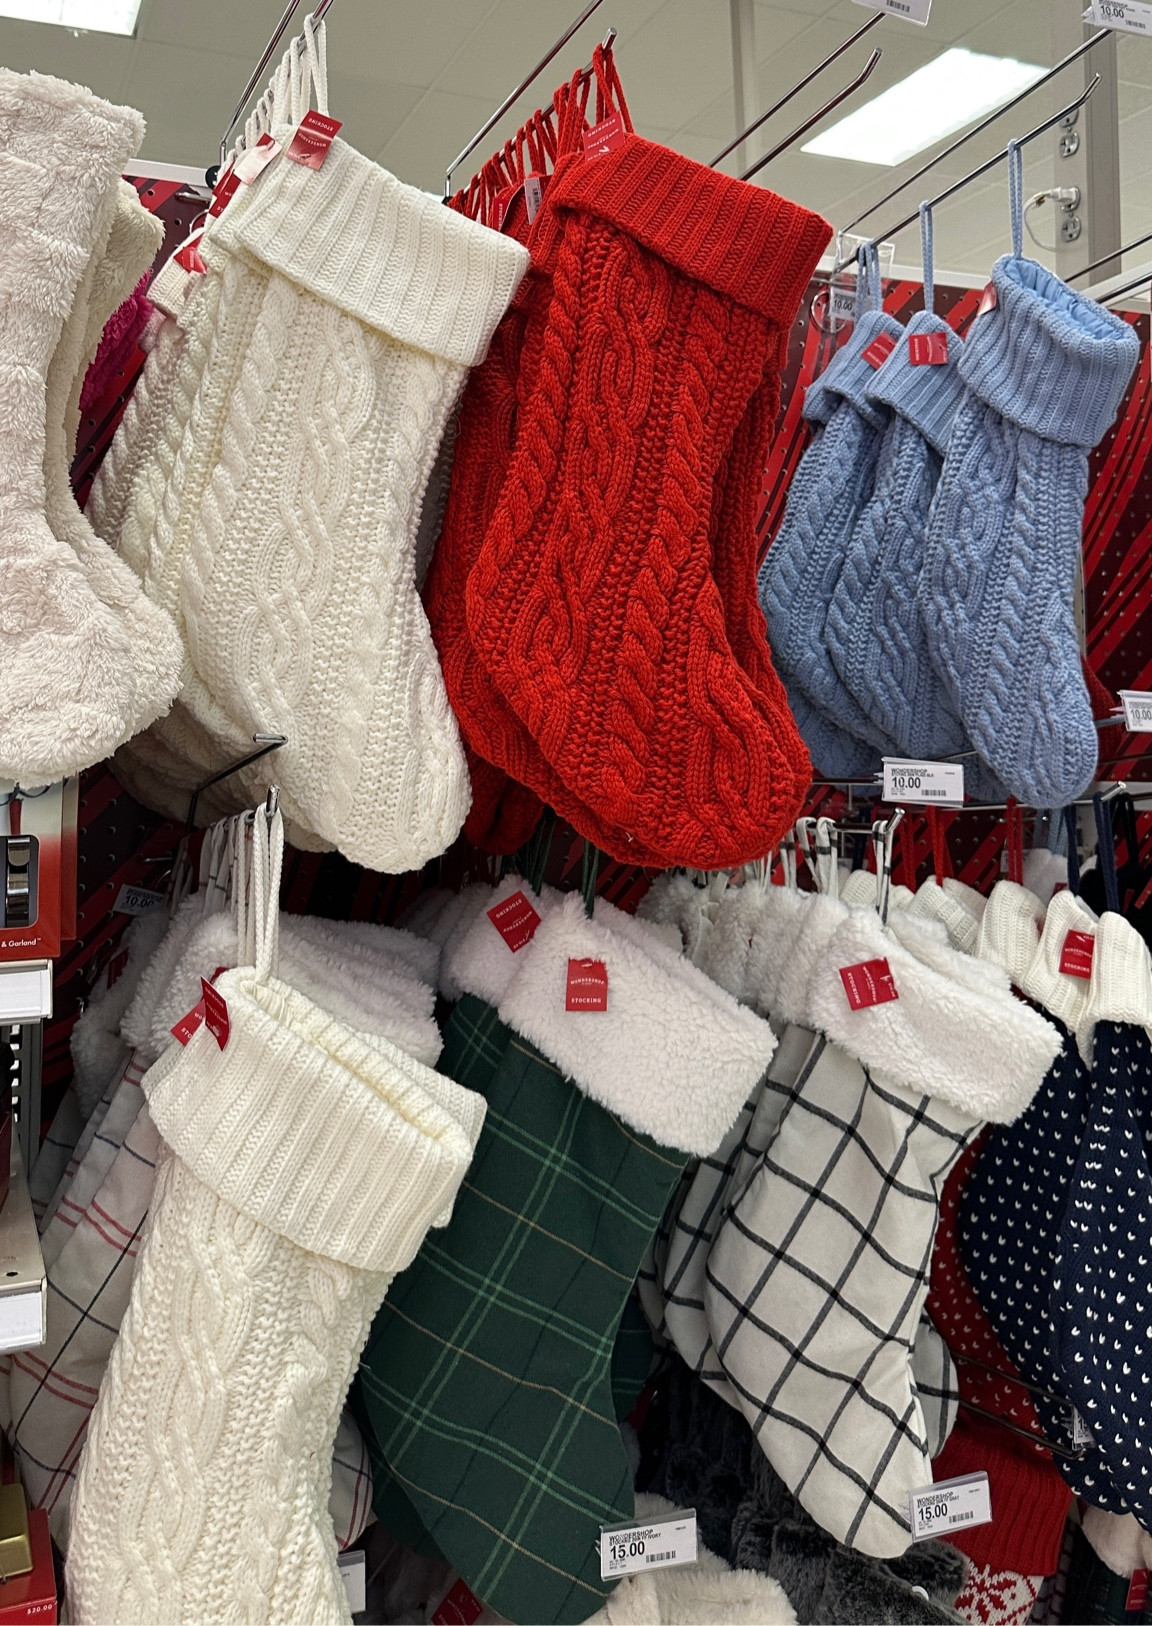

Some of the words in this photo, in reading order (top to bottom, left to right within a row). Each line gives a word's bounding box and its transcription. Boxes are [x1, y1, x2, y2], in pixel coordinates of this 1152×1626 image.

[1100, 5, 1124, 18] 10.00
[308, 117, 334, 131] STOCKING
[833, 299, 853, 311] 10.00
[1130, 709, 1152, 720] 10.00
[892, 776, 921, 789] 10.00
[495, 899, 522, 919] STOCKING
[917, 1491, 954, 1504] WONDERSHOP
[918, 1503, 948, 1521] 15.00
[610, 1541, 645, 1560] 15.00
[27, 1603, 52, 1615] $20.00
